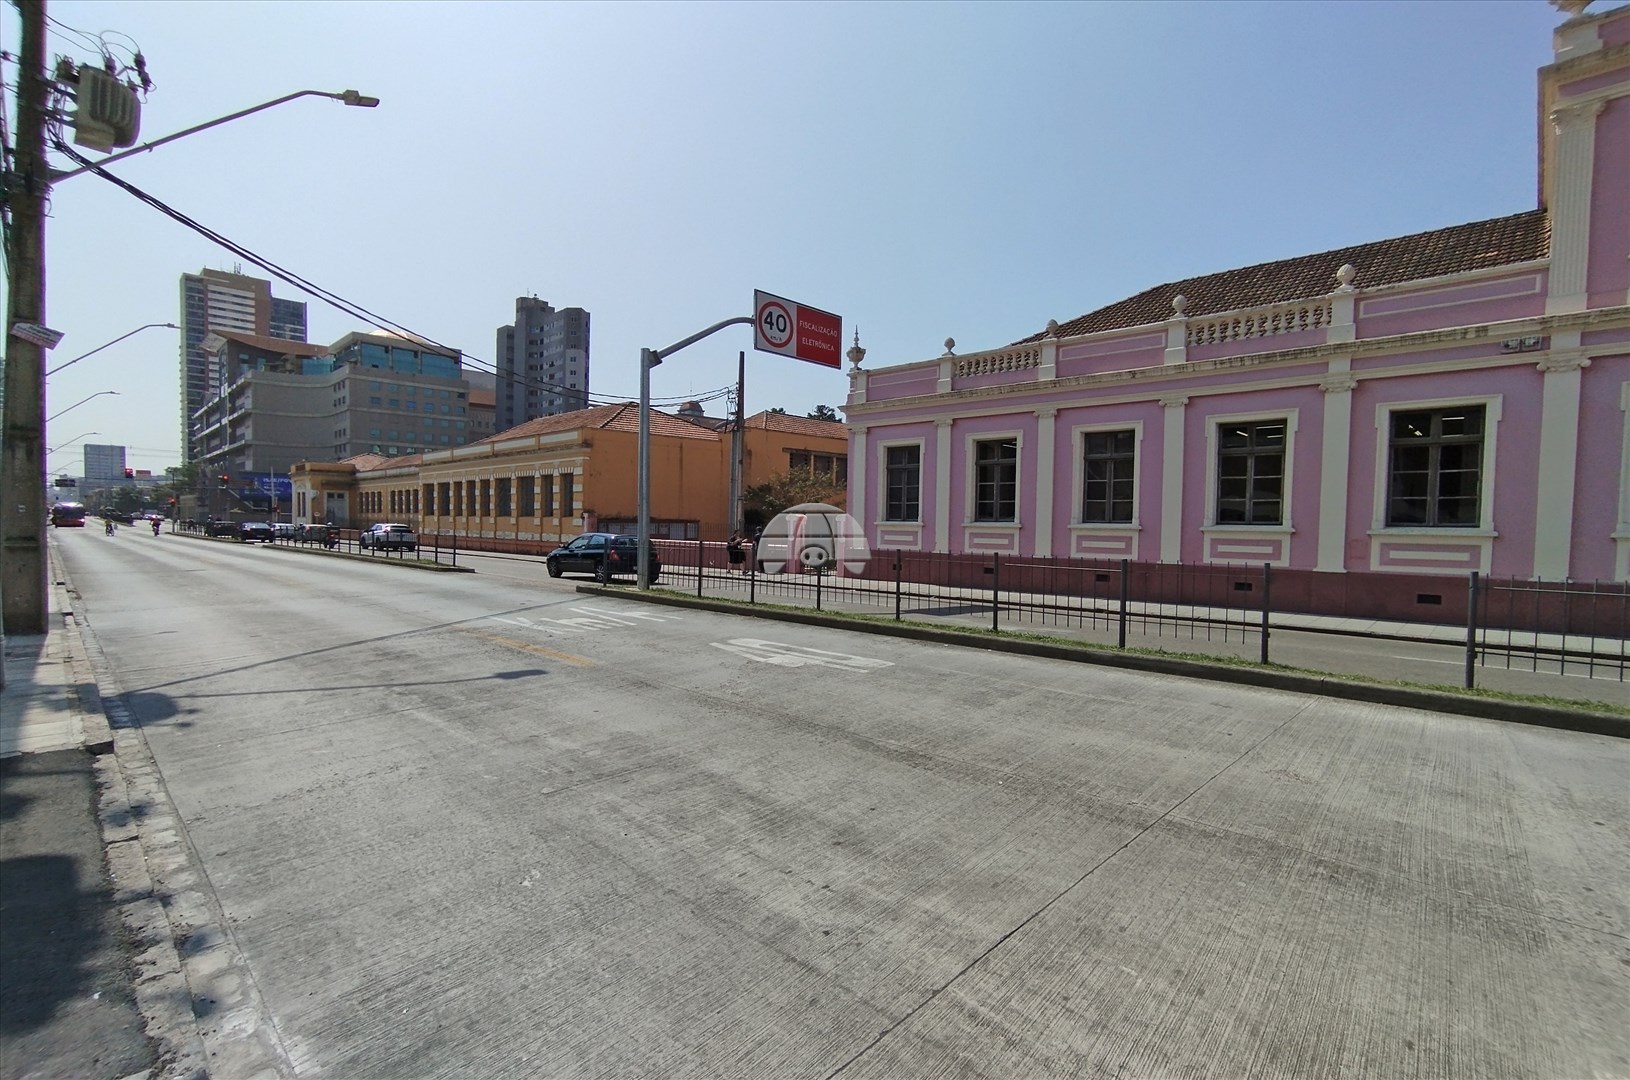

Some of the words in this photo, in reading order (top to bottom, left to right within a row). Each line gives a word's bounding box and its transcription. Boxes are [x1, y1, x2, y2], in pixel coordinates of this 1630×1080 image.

[764, 311, 787, 333] 40
[800, 320, 838, 337] FISCALIZAÇÃO
[802, 337, 835, 351] ELETRÔNICA
